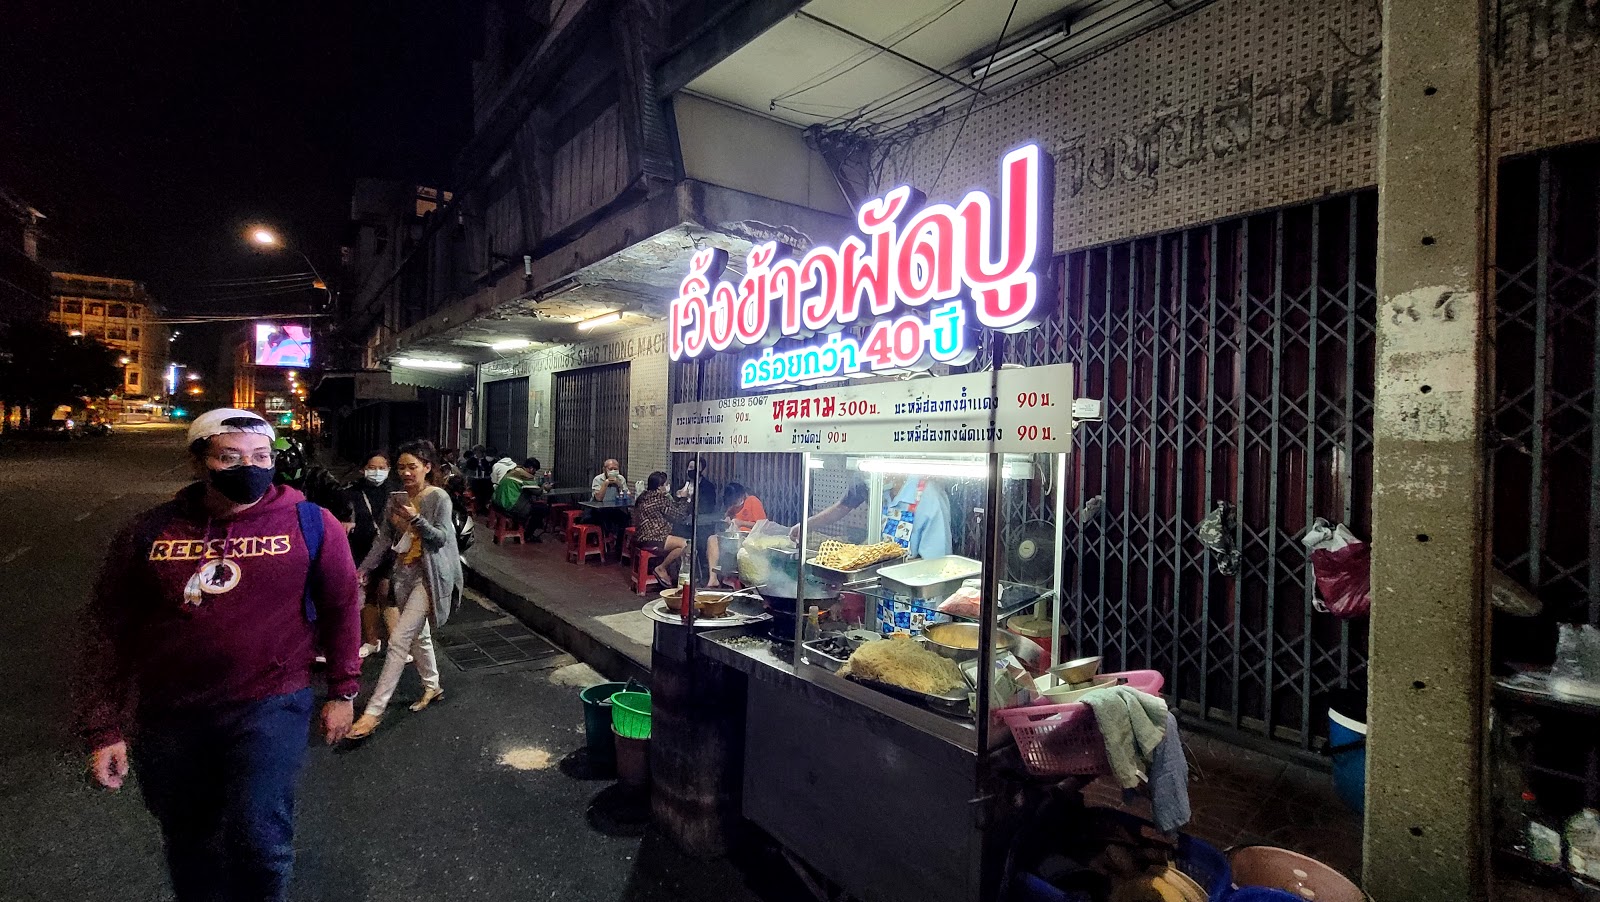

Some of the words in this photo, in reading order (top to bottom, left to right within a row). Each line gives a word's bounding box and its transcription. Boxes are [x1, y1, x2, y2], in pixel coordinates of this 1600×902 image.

[669, 144, 1039, 360] เวิ้งข้าวผัดปู
[577, 346, 600, 365] SANG
[603, 339, 634, 362] THONG
[743, 333, 857, 387] อร่อยกว่า
[866, 320, 921, 369] 40
[930, 305, 965, 356] ปี
[772, 396, 836, 433] หูฉลาม
[791, 428, 822, 450] ข้าวผัดปู
[148, 535, 291, 561] REDSKINS
